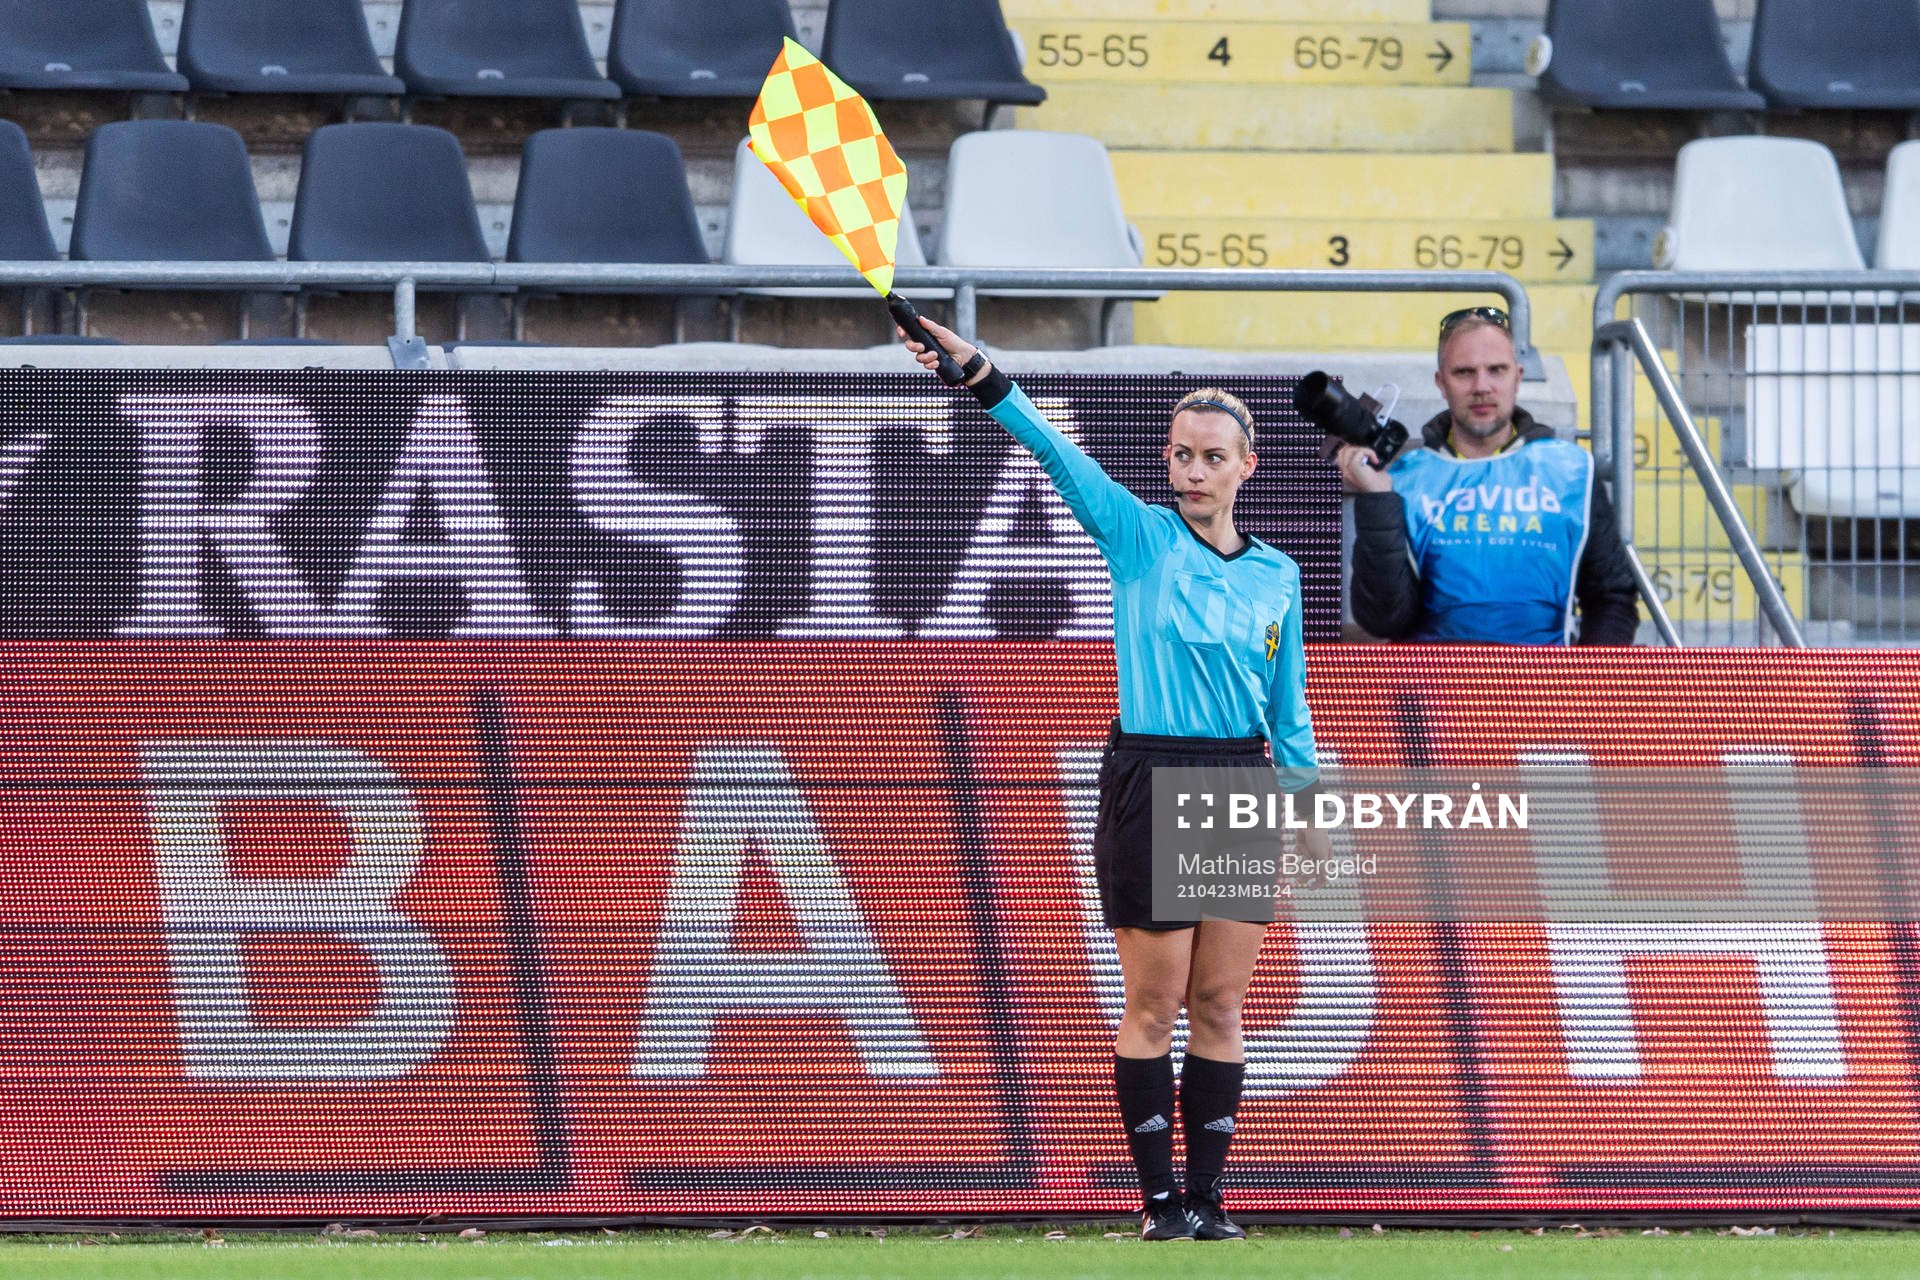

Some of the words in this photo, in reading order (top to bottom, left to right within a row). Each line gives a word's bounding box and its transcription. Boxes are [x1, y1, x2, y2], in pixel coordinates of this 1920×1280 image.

[1037, 34, 1150, 68] 55-65
[1207, 36, 1232, 67] 4
[1294, 37, 1404, 71] 66-79
[1156, 233, 1269, 267] 55-65
[1328, 236, 1350, 267] 3
[1414, 235, 1525, 270] 66-79
[114, 393, 1113, 639] RASTA
[1204, 1123, 1235, 1134] adida
